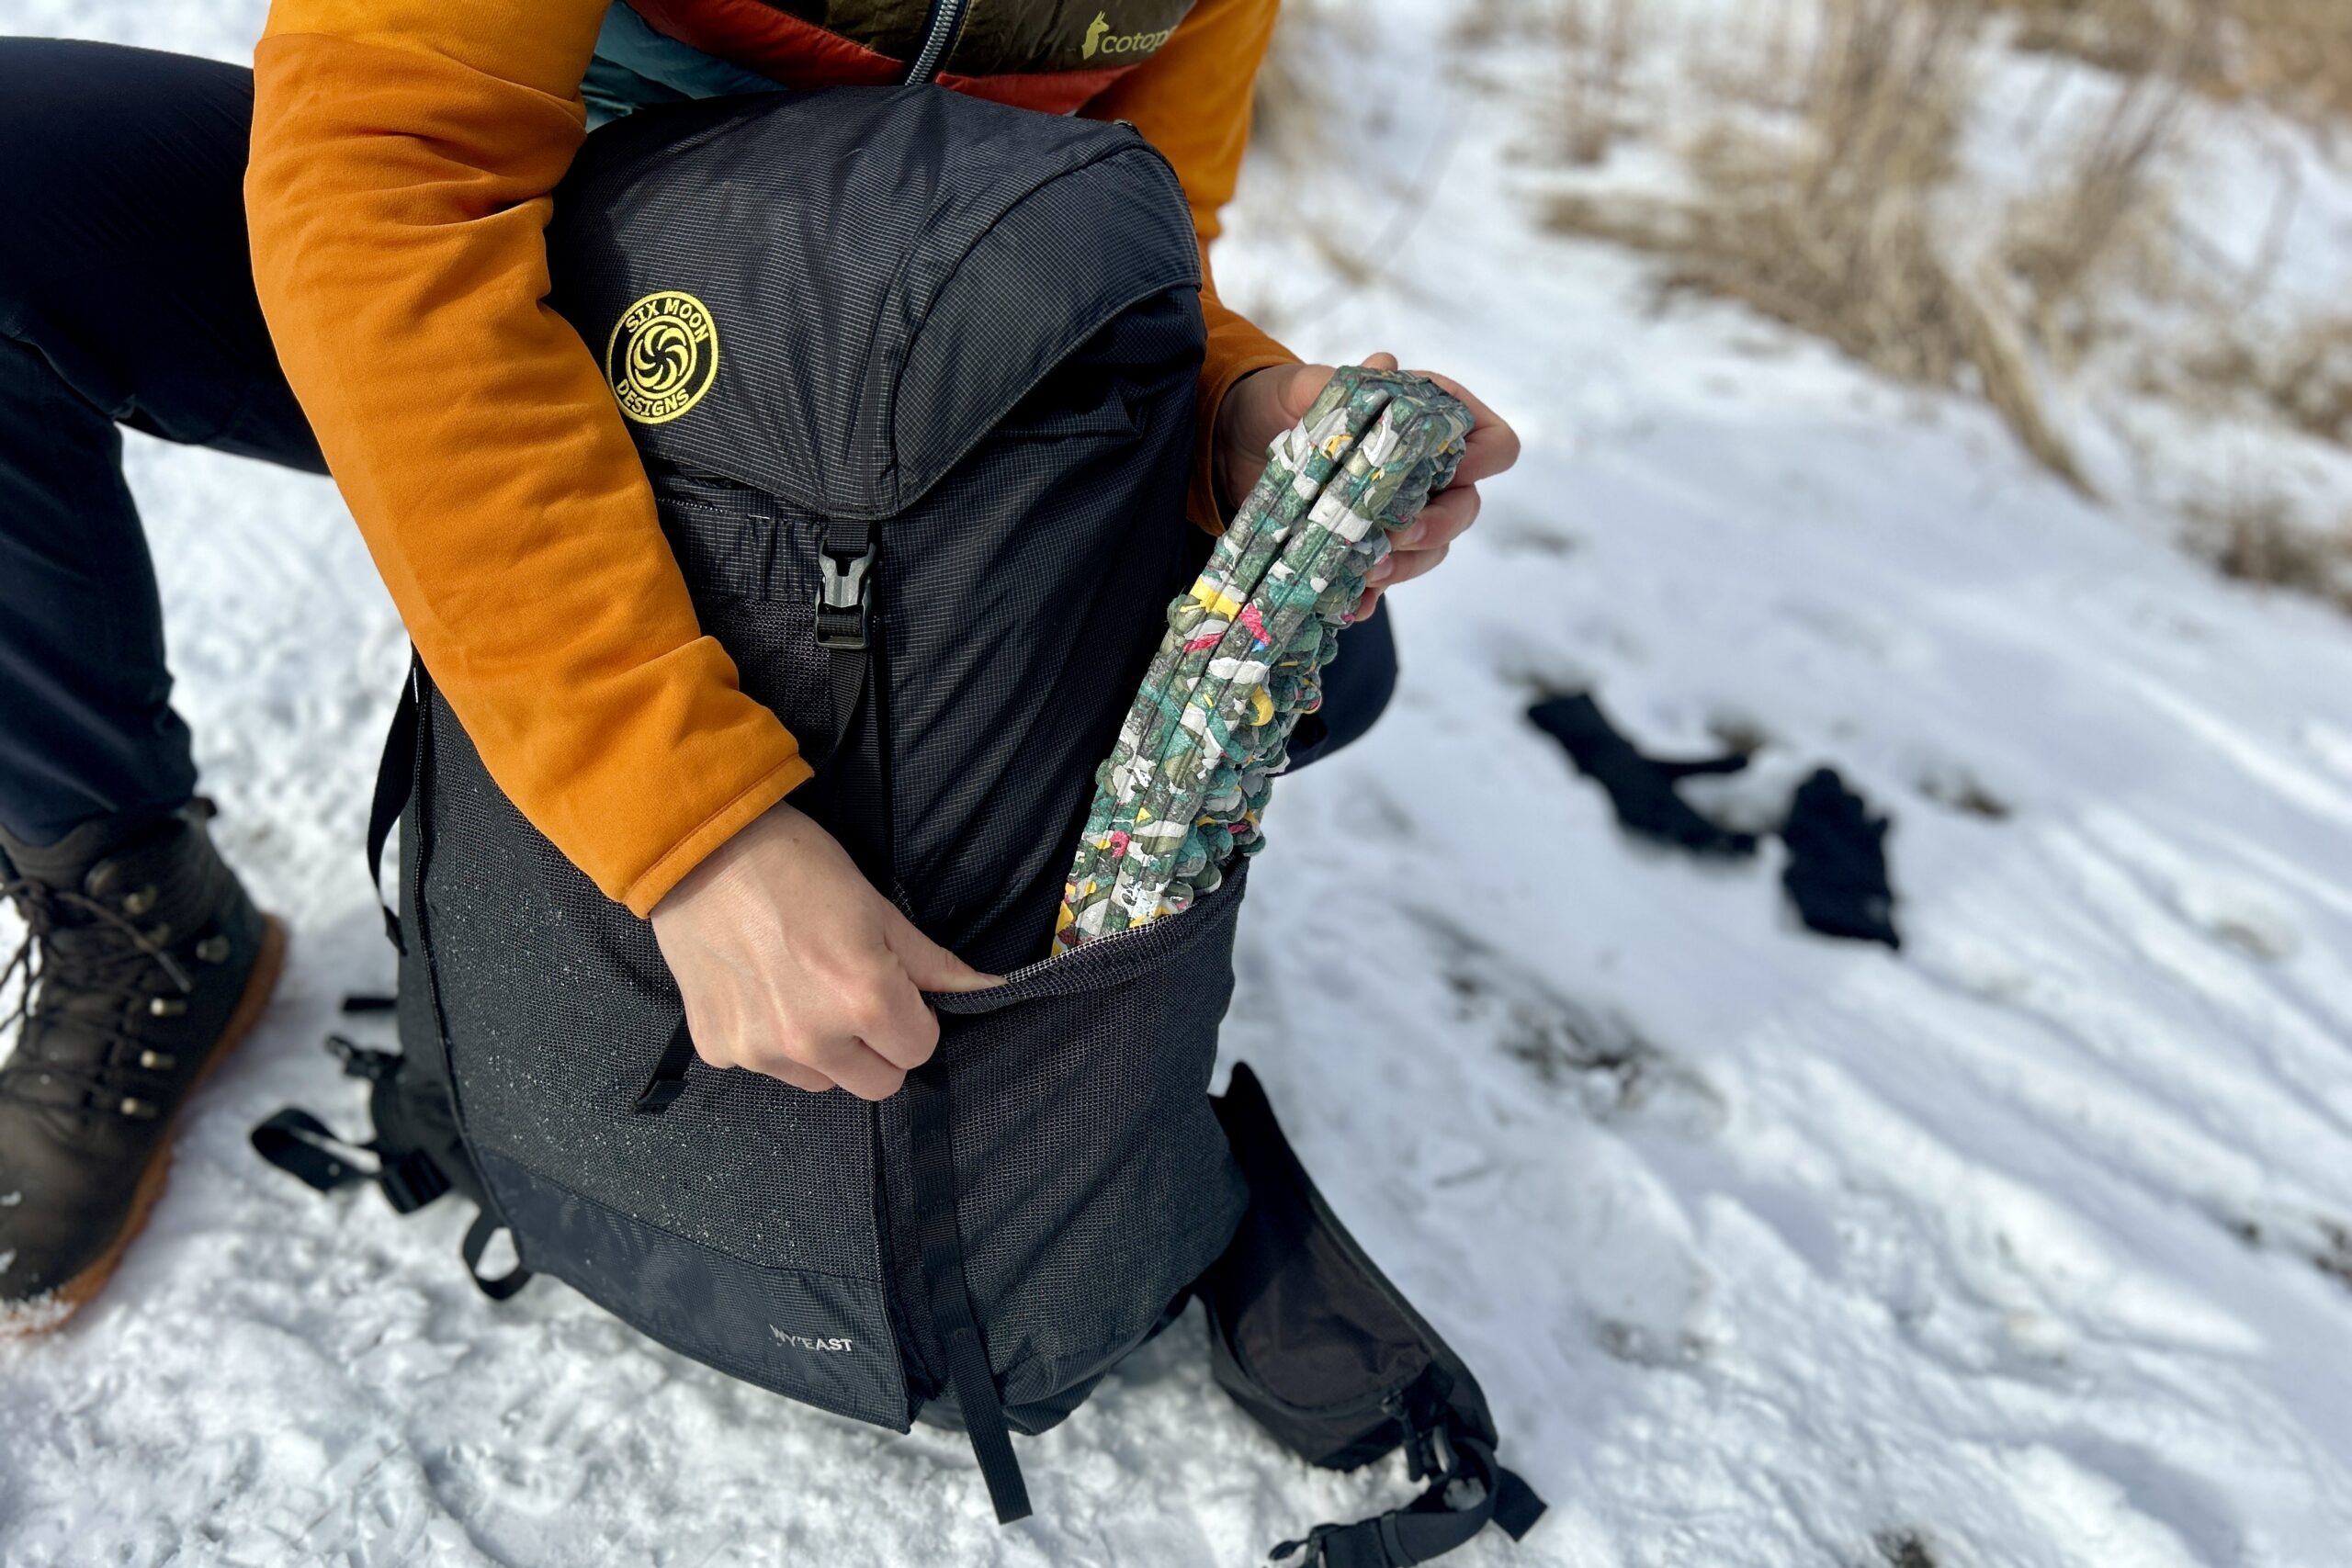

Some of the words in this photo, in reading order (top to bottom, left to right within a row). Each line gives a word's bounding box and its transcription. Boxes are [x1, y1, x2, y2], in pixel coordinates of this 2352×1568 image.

[1101, 26, 1176, 53] cotop
[626, 300, 660, 333] SIX
[663, 298, 709, 344] MOON
[616, 378, 689, 416] DESIGNS
